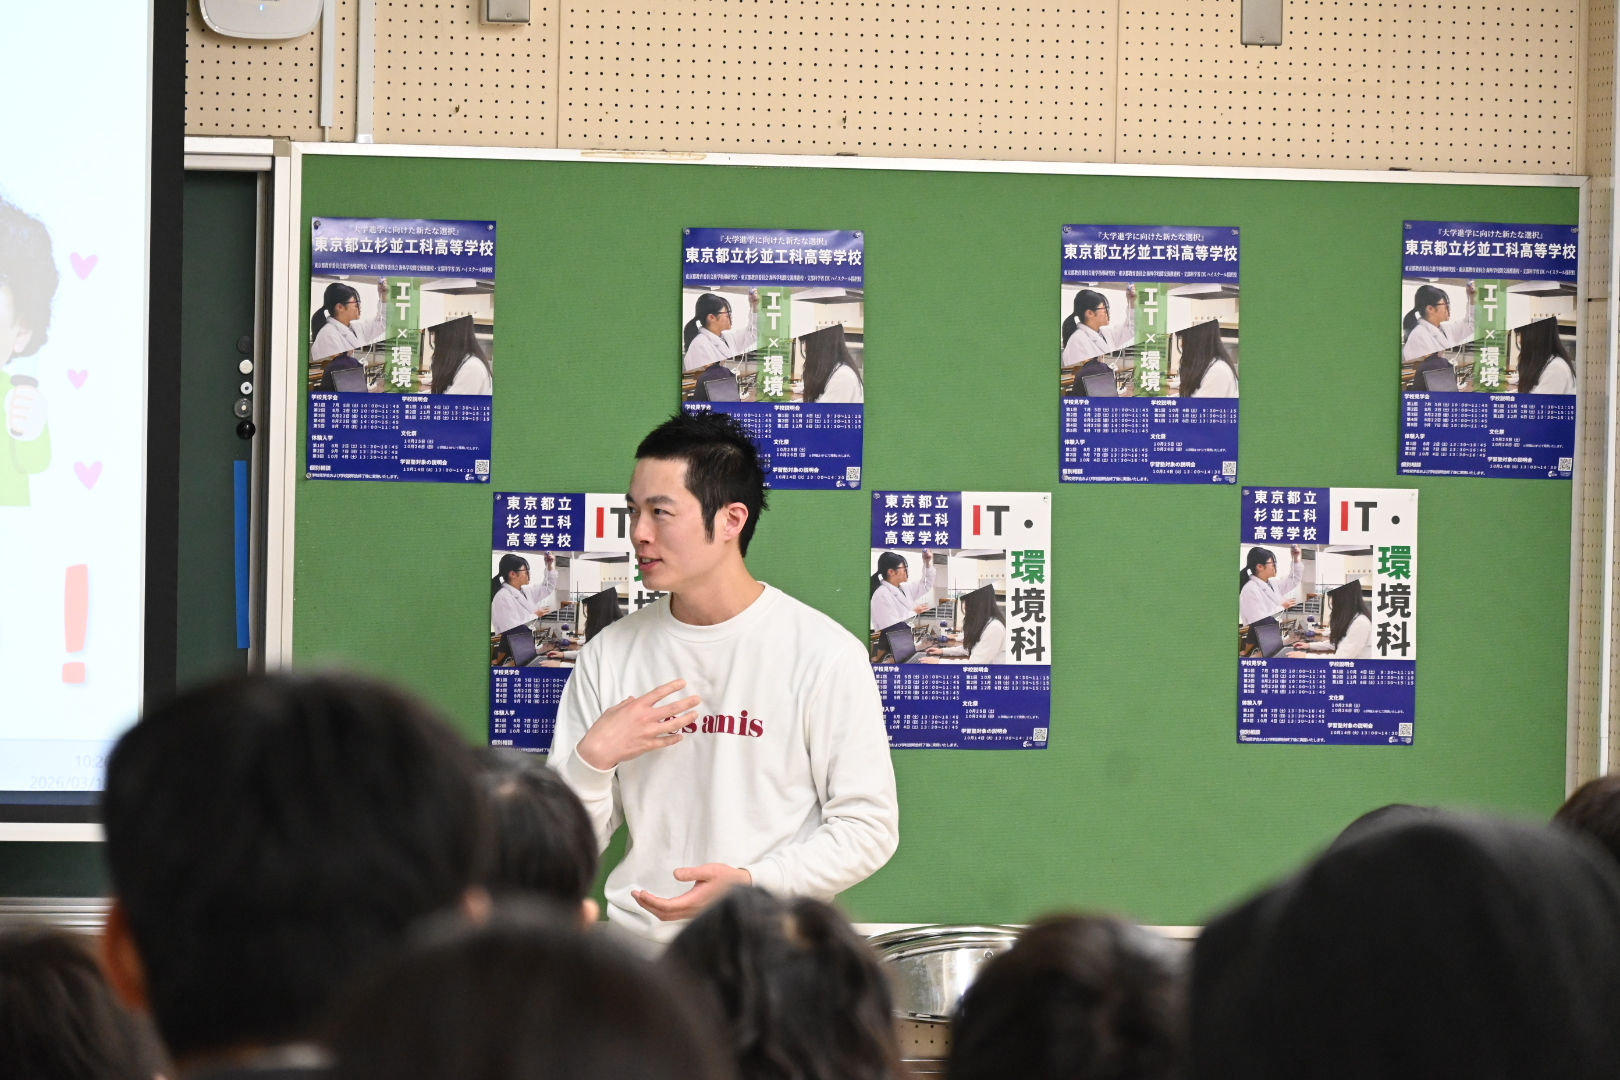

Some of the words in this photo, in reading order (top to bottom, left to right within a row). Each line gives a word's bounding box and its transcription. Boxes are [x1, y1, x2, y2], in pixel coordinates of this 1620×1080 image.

[314, 236, 494, 257] 東京都立杉並工科高等学校
[1063, 243, 1238, 262] 東京都立杉並工科高等学校
[1405, 239, 1576, 260] 東京都立杉並工科高等学校
[685, 247, 862, 266] 東京都立杉並工科高等学校
[506, 496, 572, 511] 東京都立
[884, 494, 949, 509] 東京都立
[1254, 490, 1317, 505] 東京都立
[506, 514, 572, 530] 杉並工科
[884, 512, 949, 527] 杉並工科
[1254, 508, 1317, 523] 杉並工科
[506, 532, 572, 548] 高等学校
[884, 530, 949, 545] 高等学校
[1254, 526, 1317, 541] 高等学校
[1010, 550, 1046, 662] 環境科
[1376, 545, 1412, 657] 環境科
